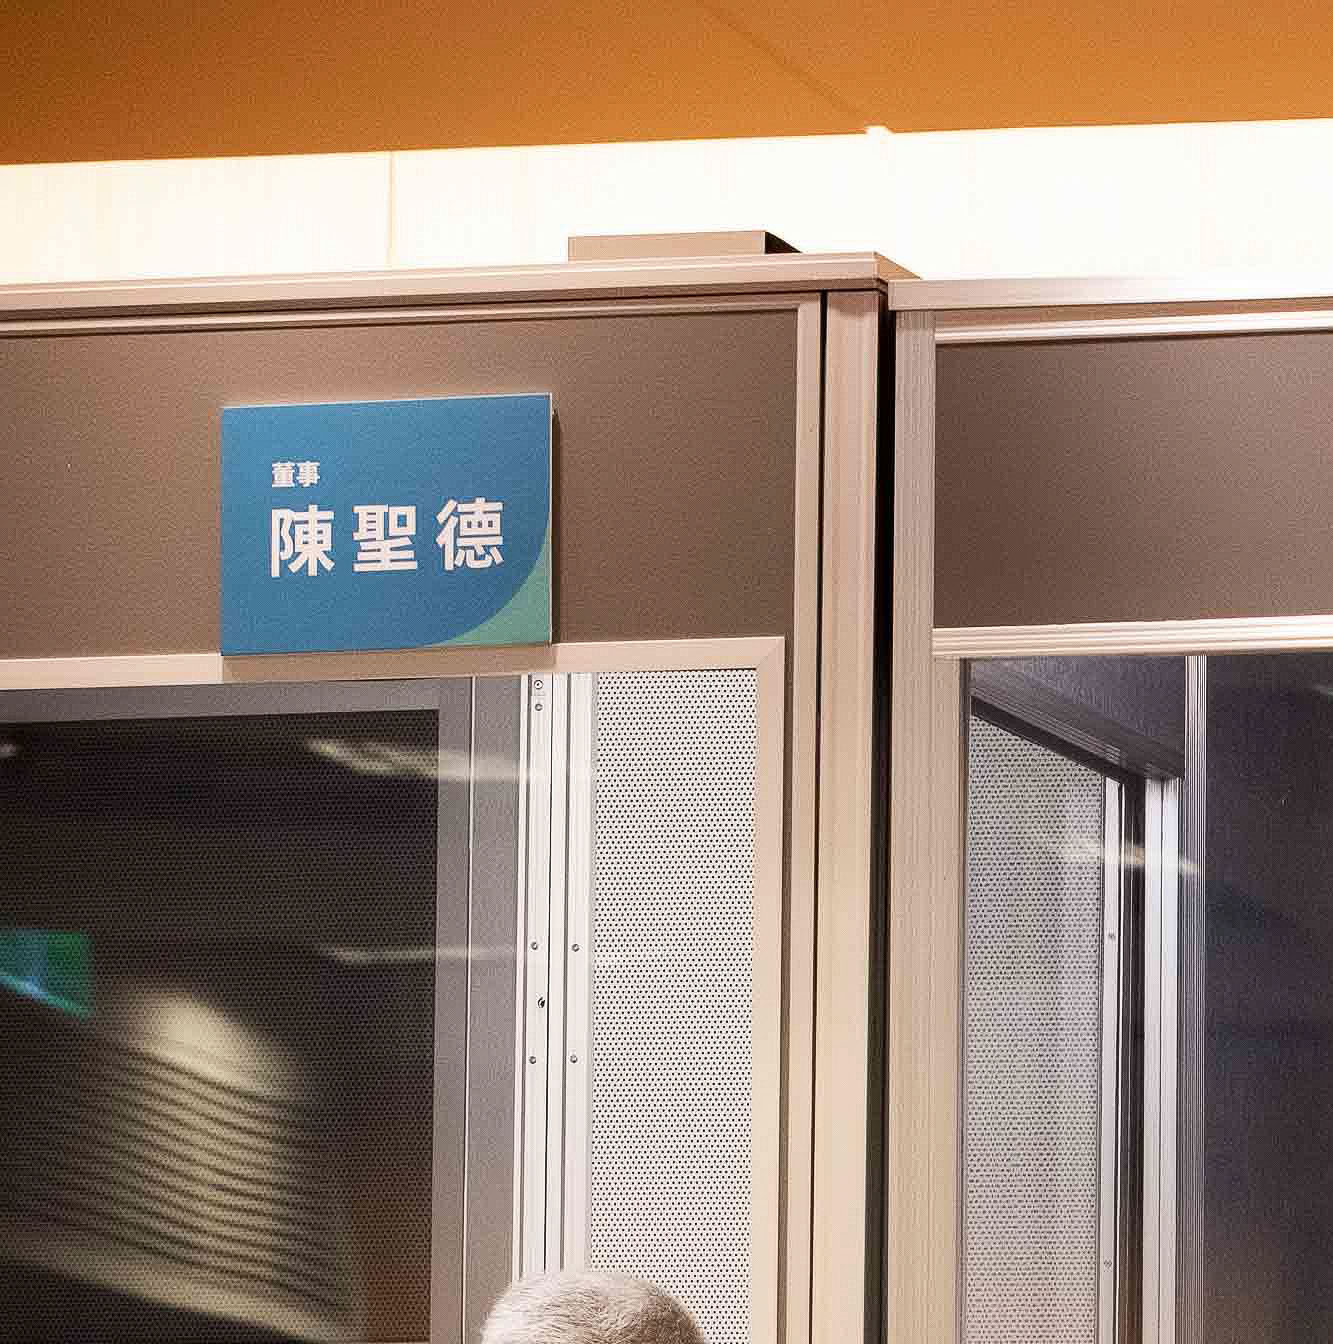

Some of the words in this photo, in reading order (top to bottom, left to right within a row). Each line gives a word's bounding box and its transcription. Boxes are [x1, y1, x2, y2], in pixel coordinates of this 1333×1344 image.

[271, 461, 321, 488] 董事
[271, 497, 504, 578] 陳聖德
